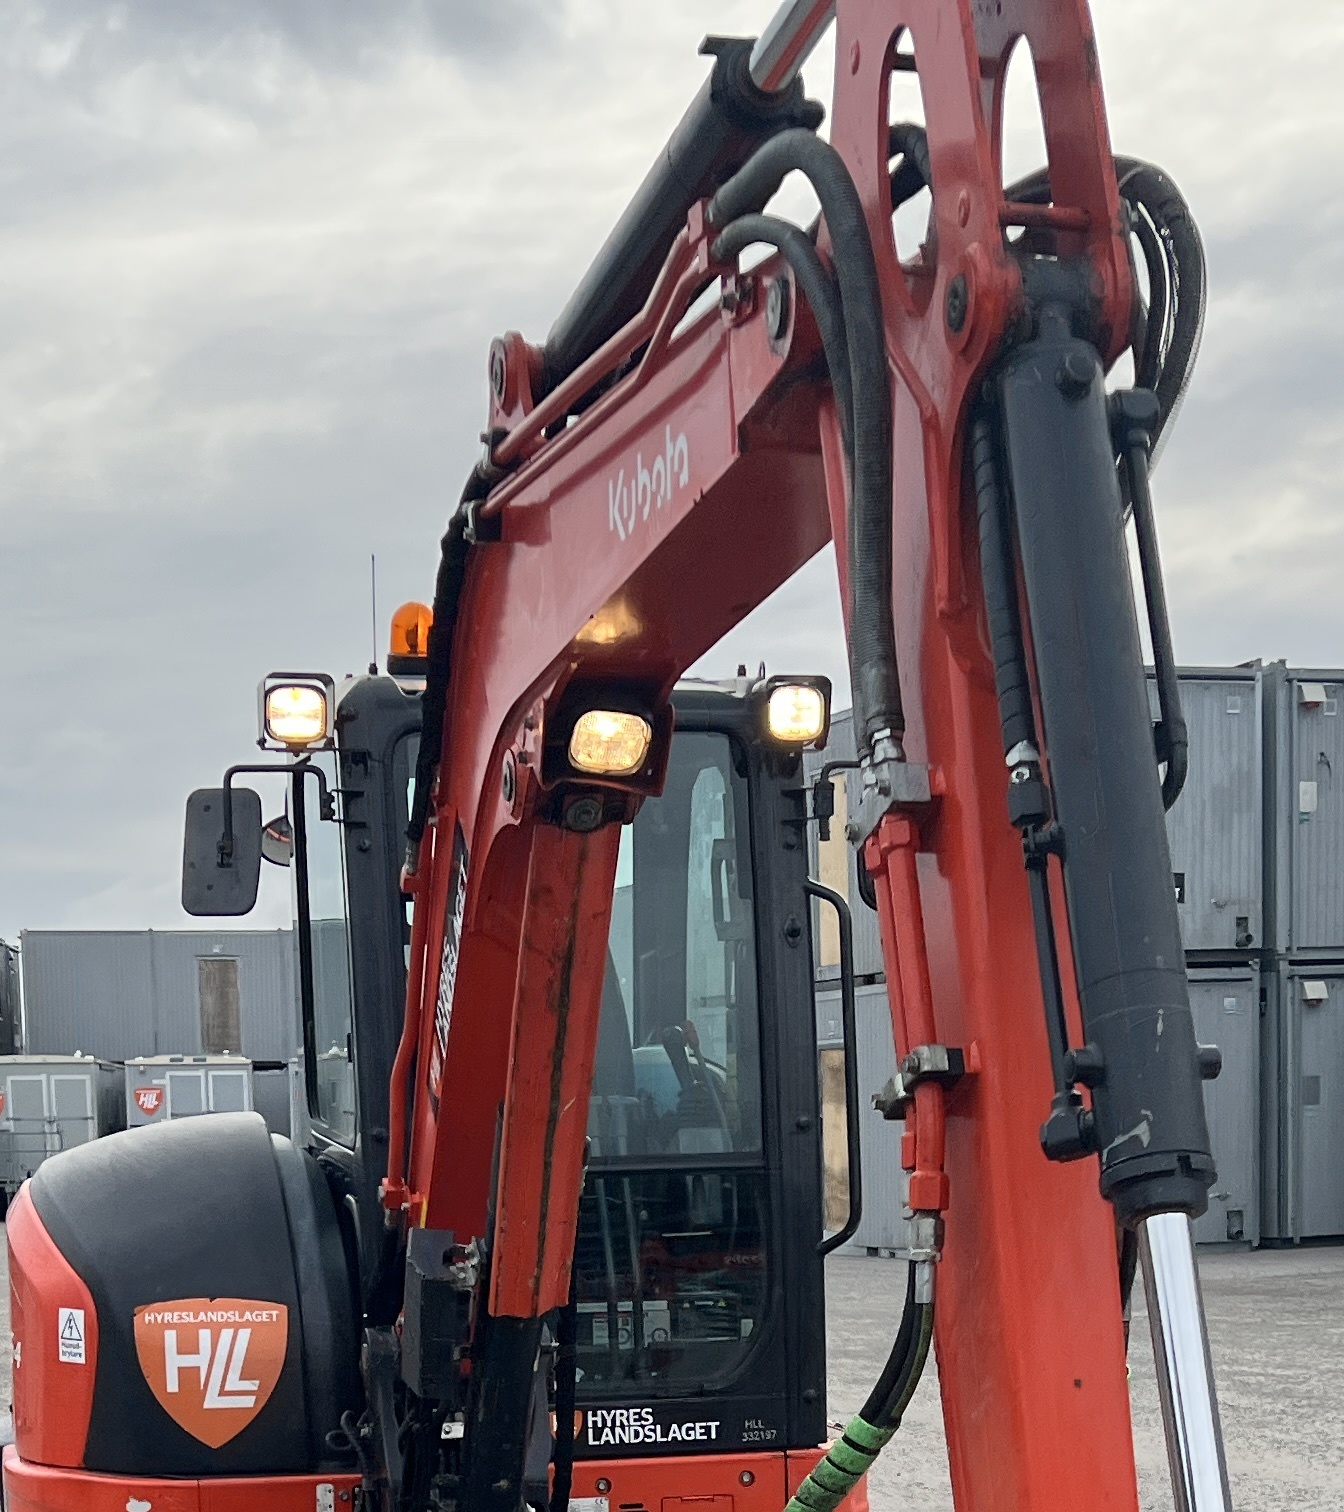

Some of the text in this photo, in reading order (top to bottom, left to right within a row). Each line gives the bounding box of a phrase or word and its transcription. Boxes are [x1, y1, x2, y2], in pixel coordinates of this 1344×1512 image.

[609, 424, 689, 541] Kubota
[144, 1310, 280, 1325] HYRESLANDSLAGET
[164, 1328, 260, 1409] HLL
[587, 1408, 654, 1428] HYRES
[744, 1419, 766, 1430] HLL
[587, 1421, 720, 1446] LANDSLAGET
